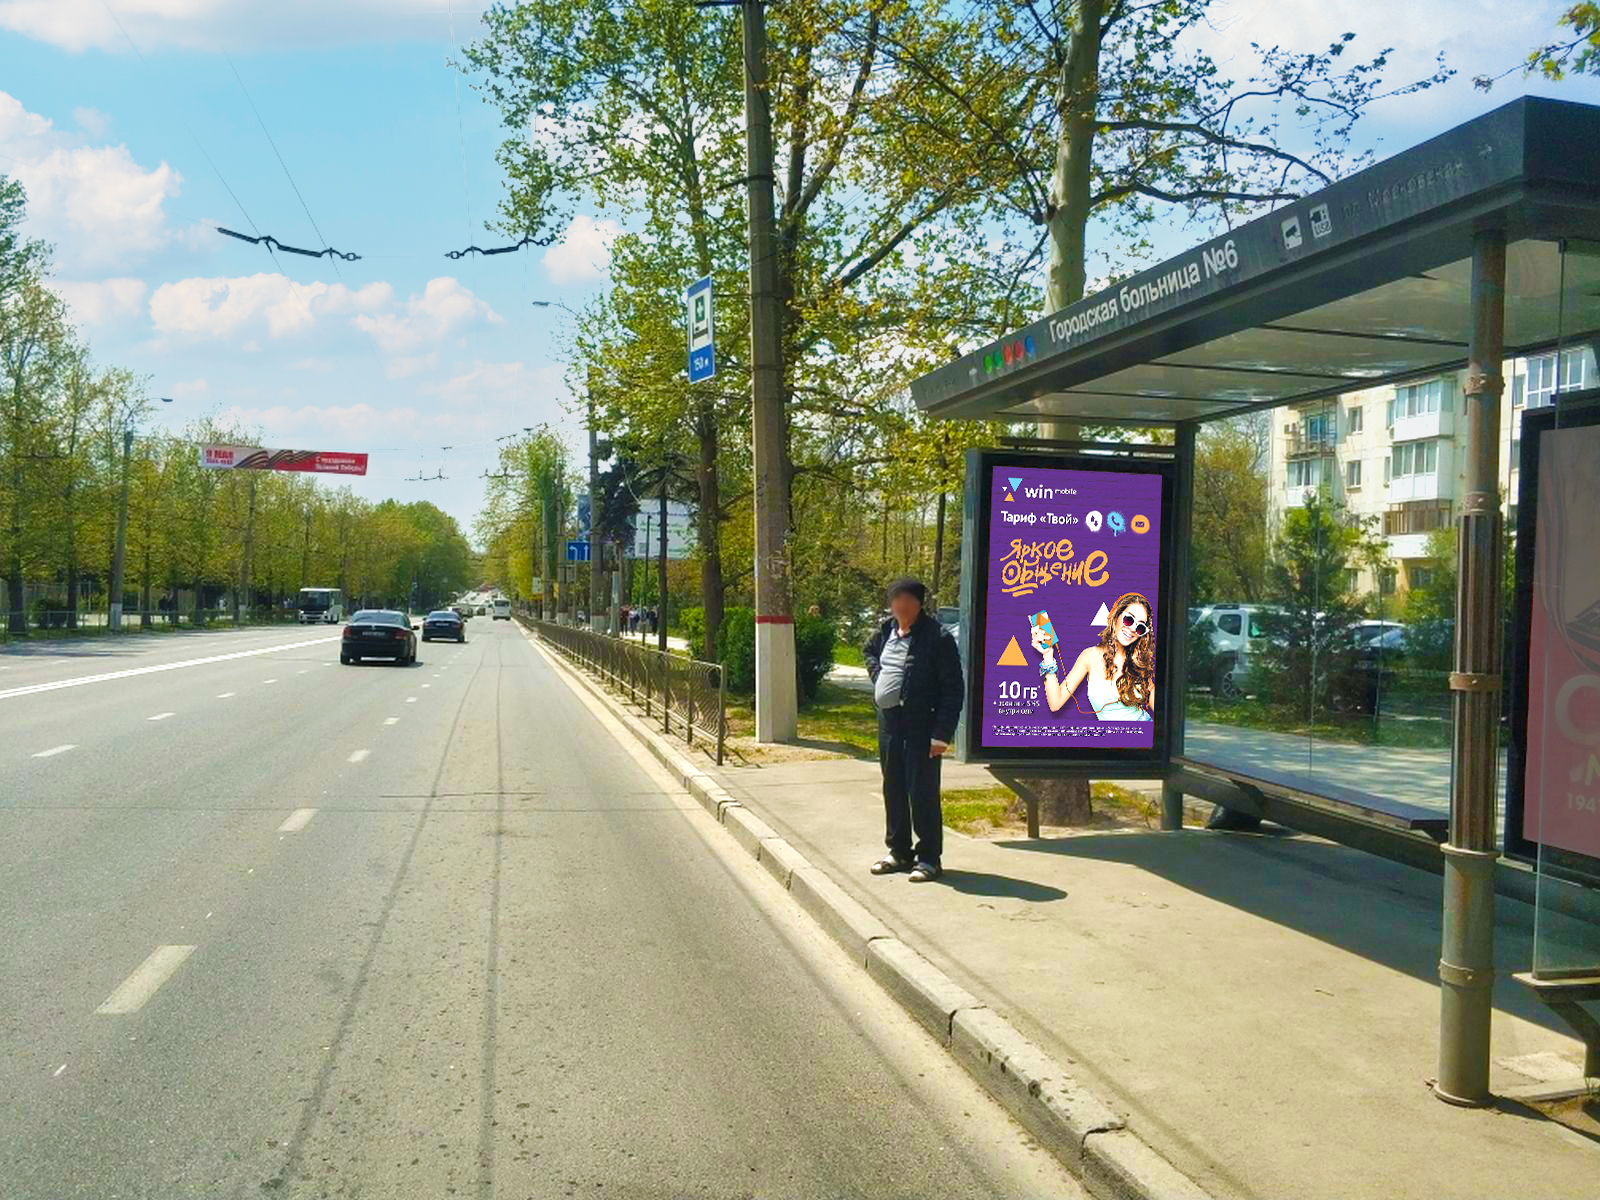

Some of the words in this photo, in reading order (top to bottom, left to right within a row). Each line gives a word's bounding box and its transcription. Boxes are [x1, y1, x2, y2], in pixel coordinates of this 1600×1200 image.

[1049, 297, 1119, 343] Городская
[1119, 262, 1200, 313] больница
[1202, 239, 1239, 279] №6
[1024, 484, 1053, 499] win
[1054, 487, 1077, 496] mobile
[1001, 510, 1037, 526] Тариф
[1040, 512, 1079, 525] «Твой»
[998, 680, 1021, 699] 10
[1567, 793, 1600, 814] 194
